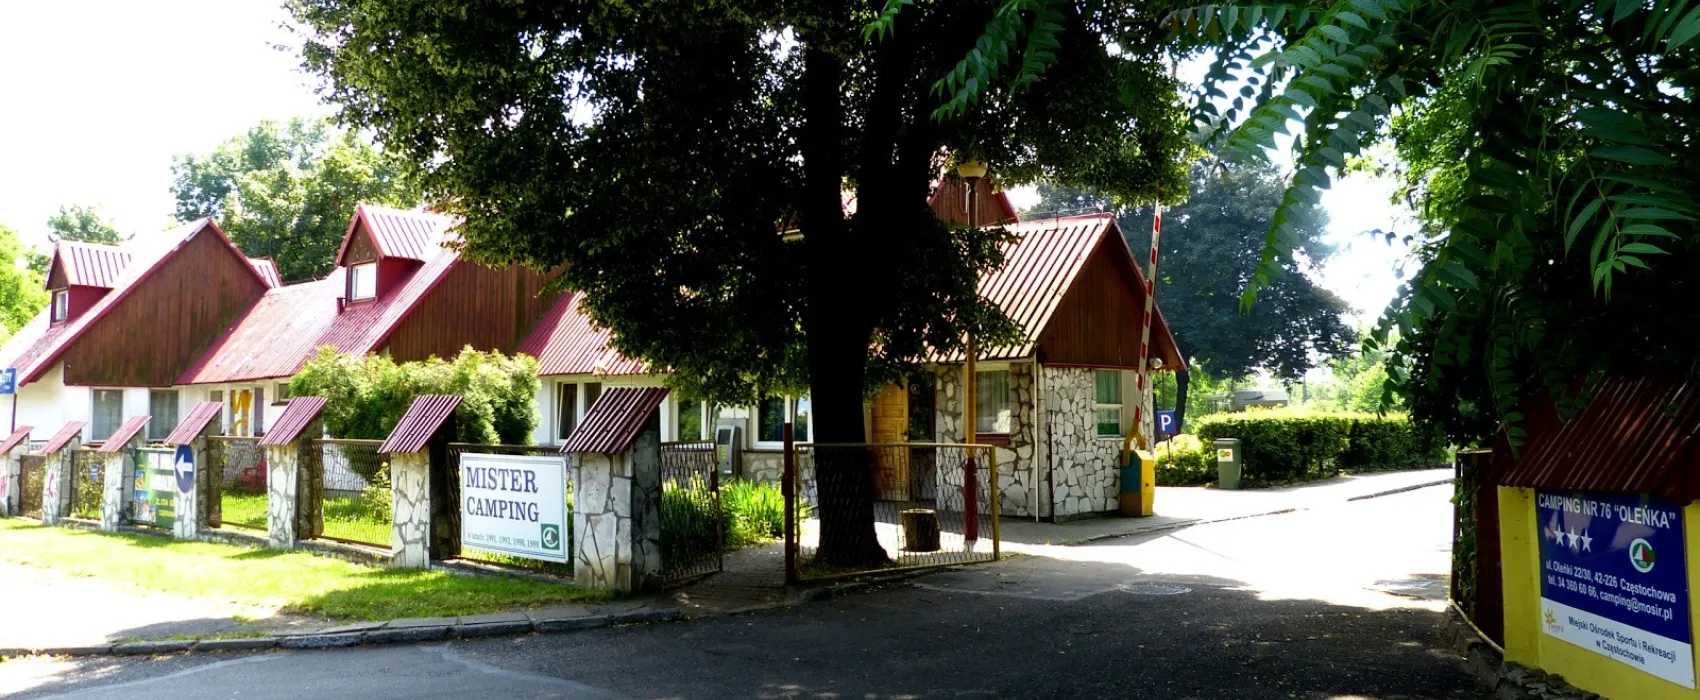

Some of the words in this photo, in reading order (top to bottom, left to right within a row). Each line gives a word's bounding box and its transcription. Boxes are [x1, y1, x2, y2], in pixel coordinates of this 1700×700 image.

[1161, 414, 1171, 431] P
[466, 466, 538, 493] MISTER
[466, 496, 539, 522] CAMPING
[1538, 493, 1580, 514] CAMPING
[1583, 500, 1598, 517] NR
[1600, 502, 1612, 519] 76
[1548, 574, 1557, 586] tel.
[1558, 576, 1565, 588] 34
[1600, 590, 1673, 622] camping@mosir.pl
[1595, 571, 1618, 588] 42-226
[1620, 577, 1676, 603] Częstochowa
[1568, 616, 1589, 630] Miejski
[1589, 622, 1615, 640] Ośrodek
[1616, 631, 1638, 648] Sportu
[1642, 640, 1677, 663] Rekreacji
[1596, 639, 1601, 648] w
[1601, 640, 1645, 664] Częstochowie
